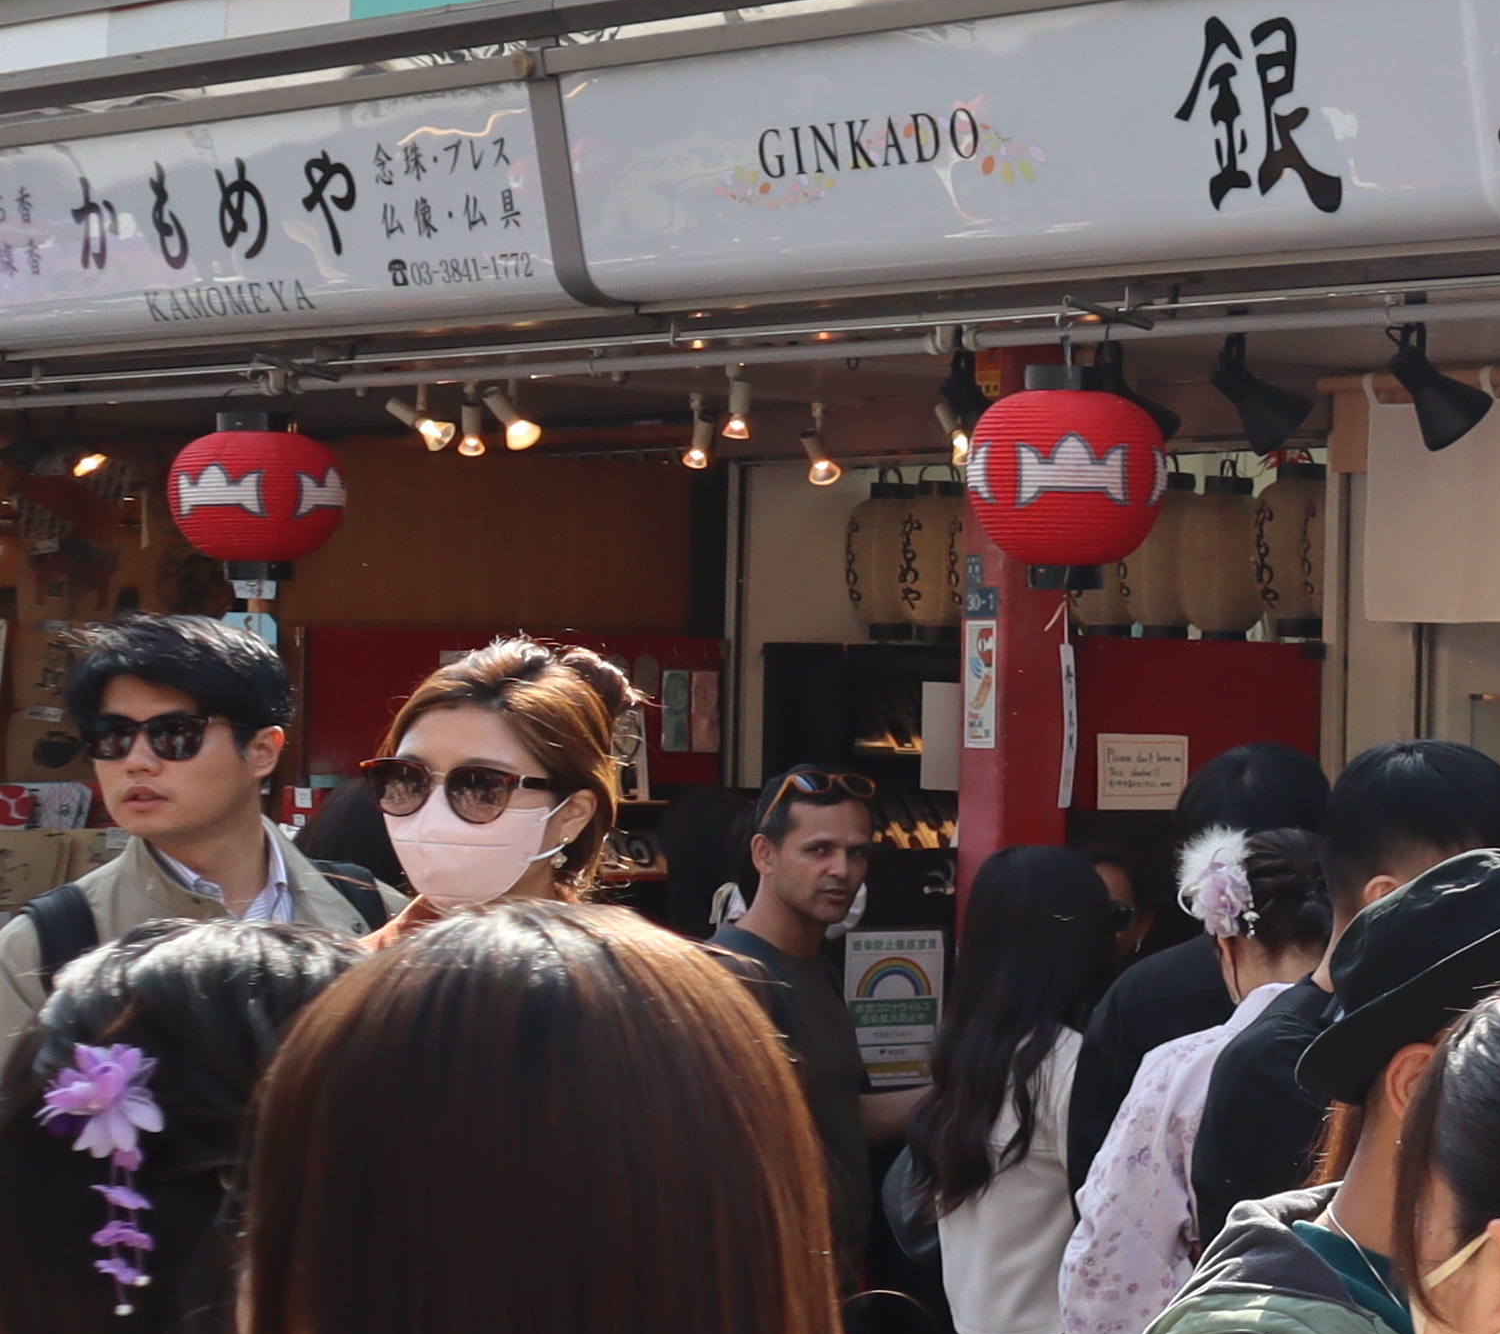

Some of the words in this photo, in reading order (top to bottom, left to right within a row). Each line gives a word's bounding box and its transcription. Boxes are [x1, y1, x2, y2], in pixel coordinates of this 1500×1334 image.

[758, 108, 979, 179] GINKADO
[71, 150, 356, 269] かもめや
[381, 188, 522, 239] 仏像・仏具
[410, 252, 534, 287] 03-3841-1772
[143, 280, 316, 323] KAMOMEYA
[966, 593, 994, 611] 30-1
